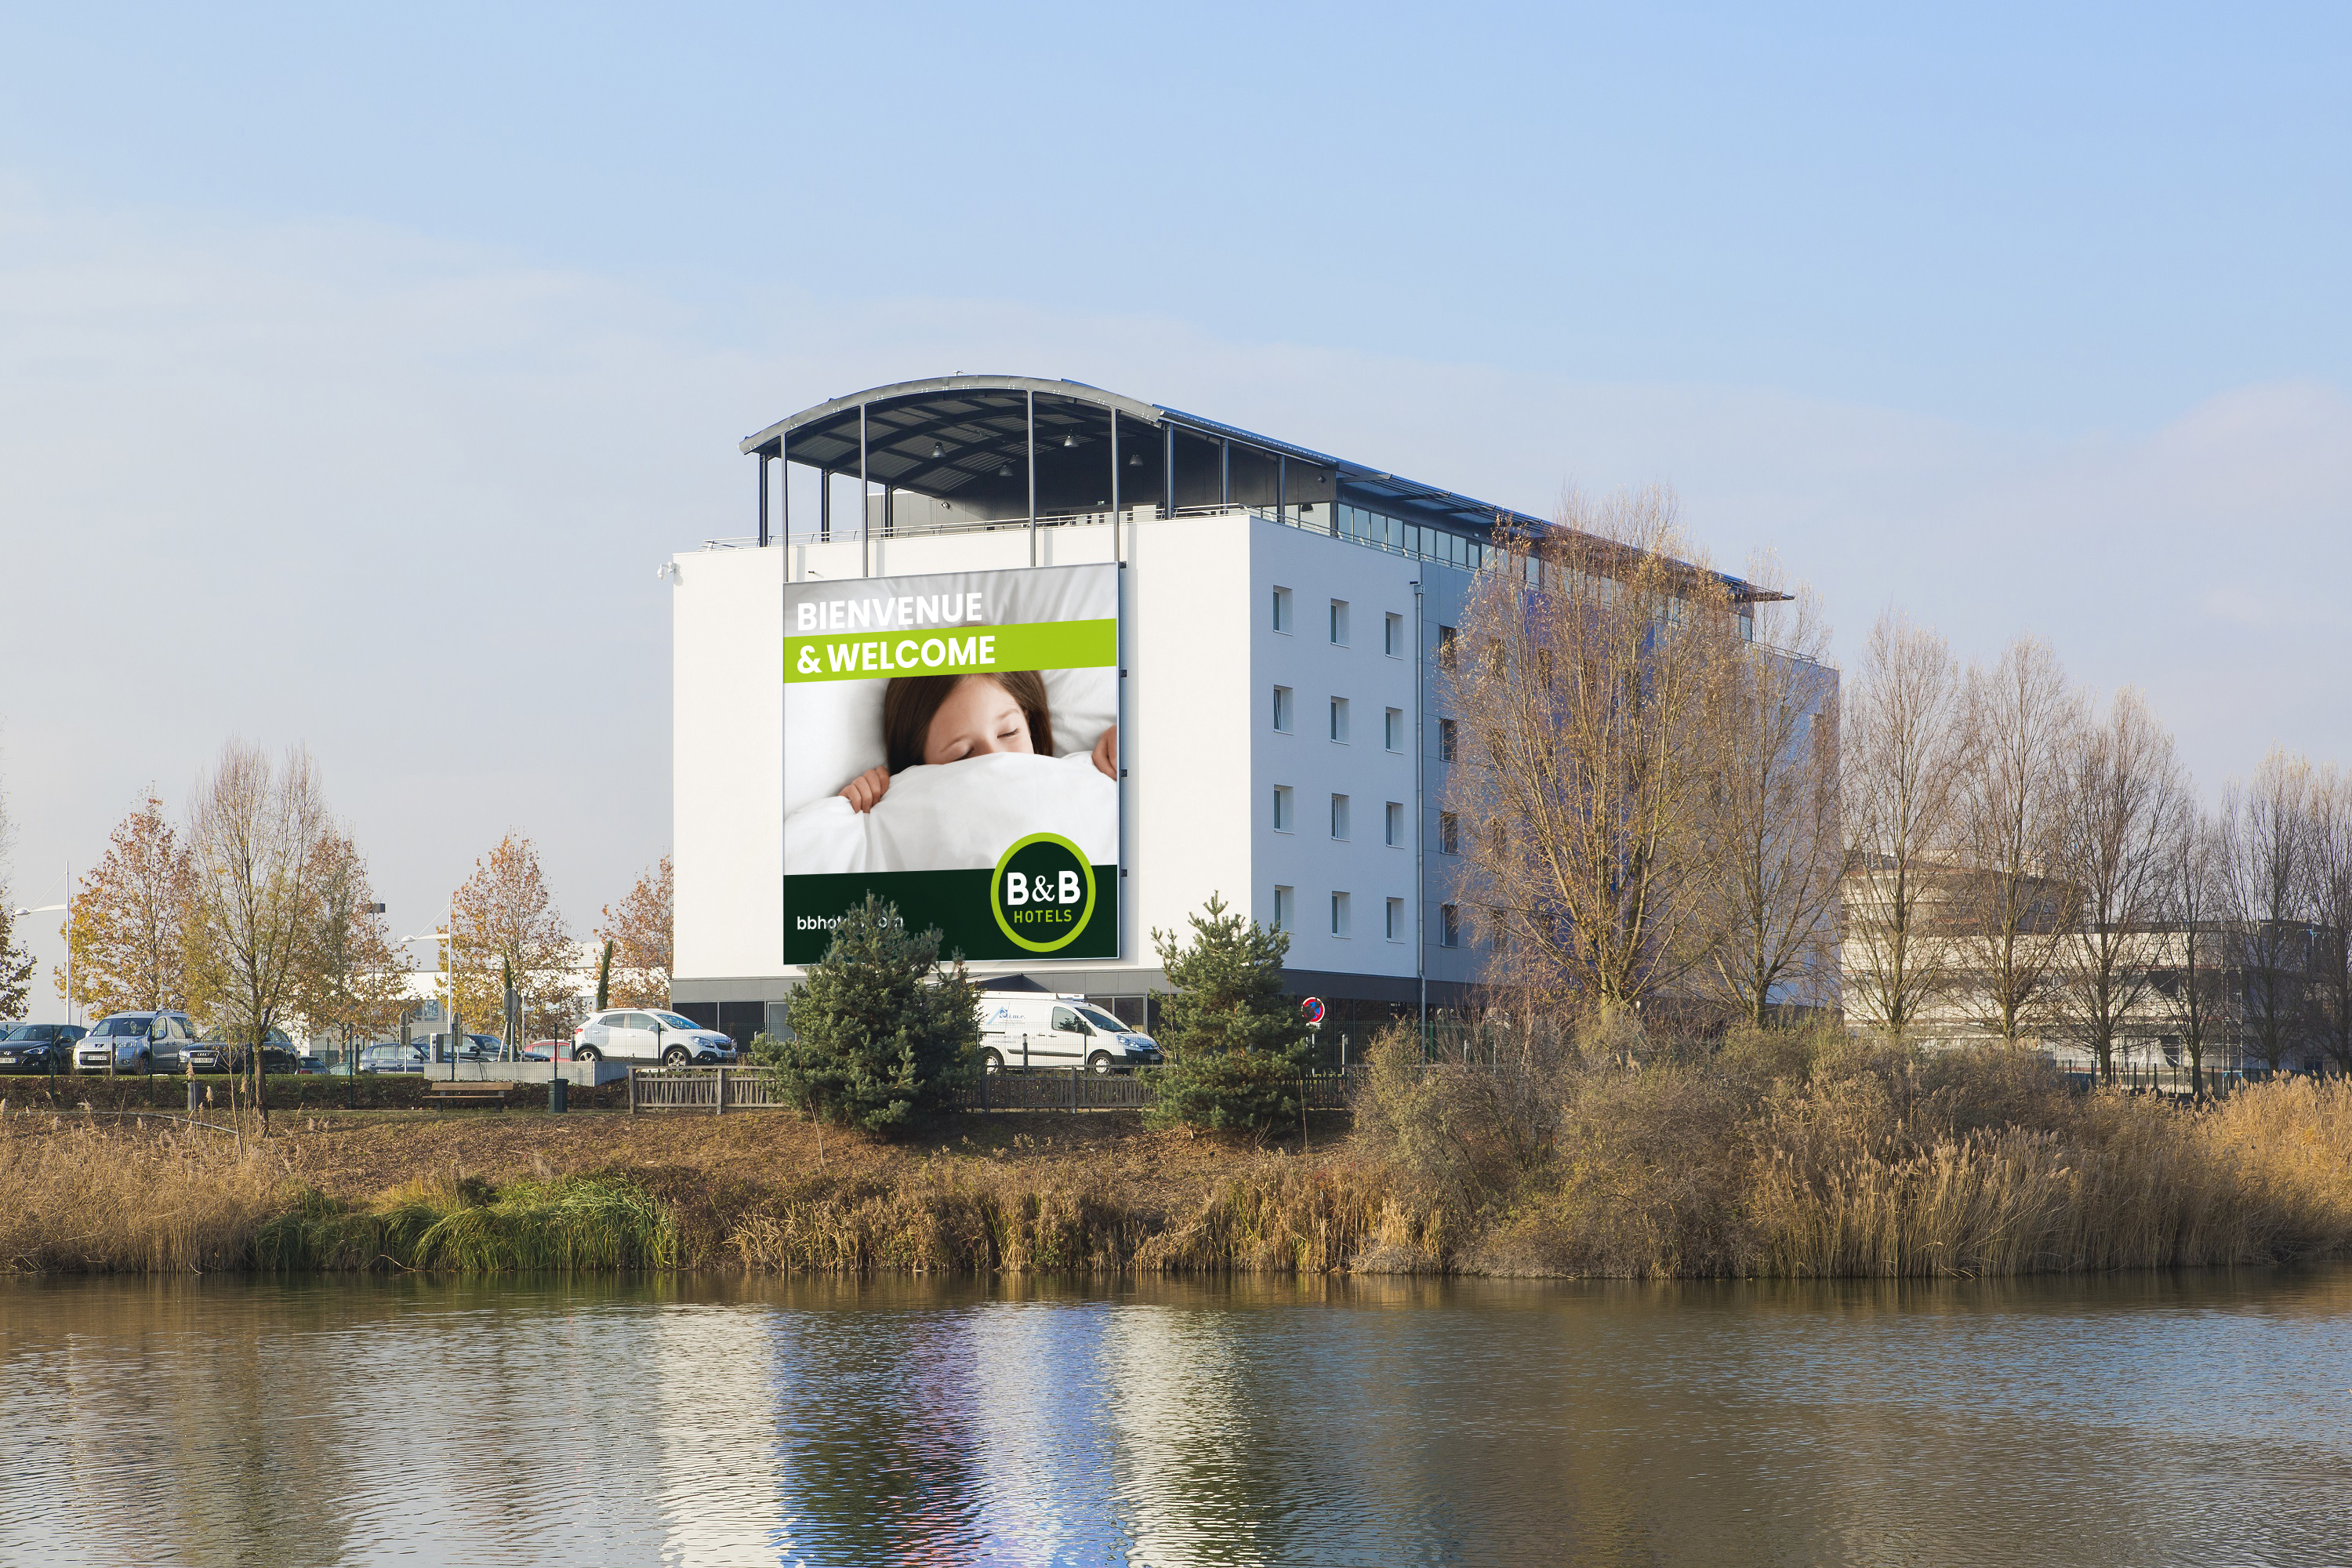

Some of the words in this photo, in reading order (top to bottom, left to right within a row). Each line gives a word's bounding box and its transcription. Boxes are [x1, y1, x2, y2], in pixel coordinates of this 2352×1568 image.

[797, 592, 982, 631] BIENVENUE
[797, 645, 822, 674] &
[826, 635, 996, 673] WELCOME
[1007, 870, 1081, 906] B&B
[1014, 909, 1073, 924] HOTELS
